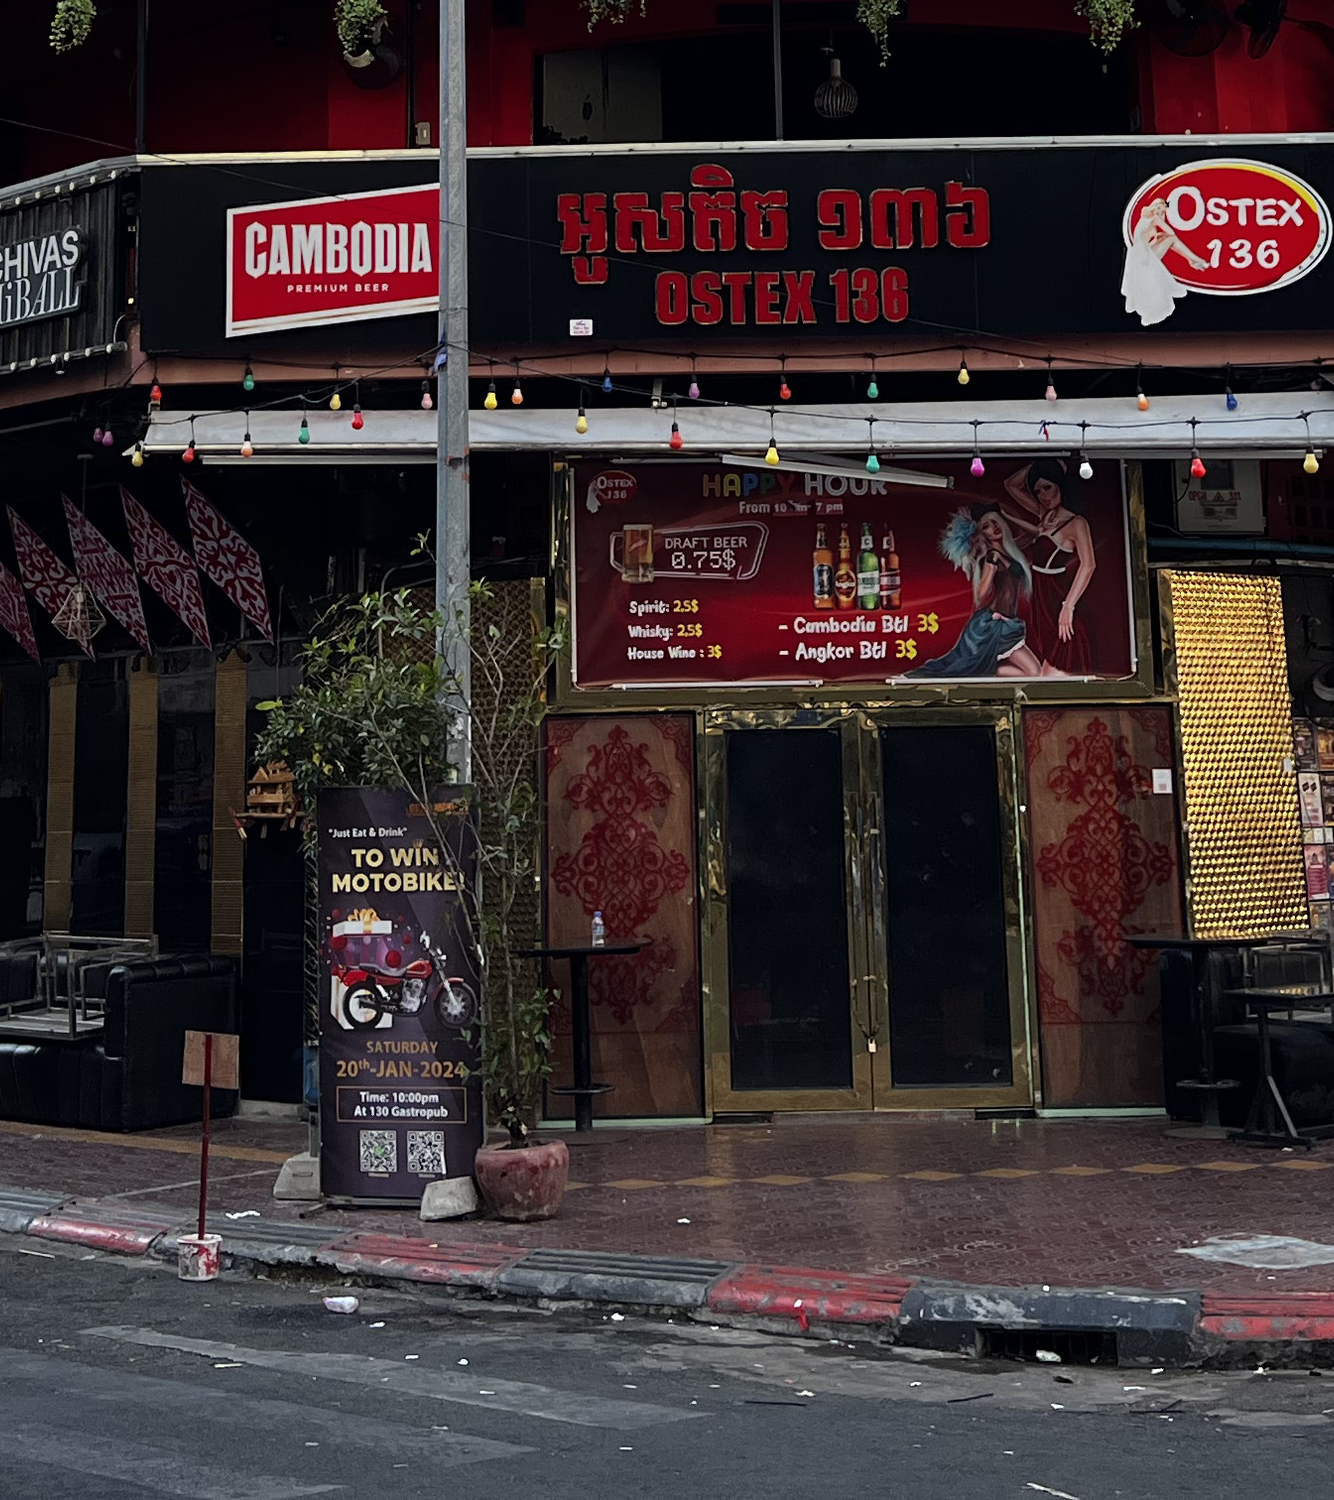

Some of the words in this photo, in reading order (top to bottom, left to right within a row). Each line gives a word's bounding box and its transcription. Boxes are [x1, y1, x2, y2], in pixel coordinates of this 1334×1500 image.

[817, 181, 990, 250] ១៣៦
[1167, 185, 1304, 231] OSTEX
[245, 221, 432, 279] CAMBODIA
[1207, 238, 1280, 269] 136
[287, 284, 348, 293] PREMIUM
[354, 283, 389, 292] BEER
[655, 269, 817, 325] OSTEX
[829, 266, 909, 324] 136
[703, 473, 796, 498] HAPPY
[804, 473, 888, 496] HOUR
[739, 502, 771, 514] From
[826, 503, 843, 514] pm
[665, 537, 709, 549] DRAFT
[714, 536, 748, 548] BEER
[671, 549, 736, 570] 0.75$
[629, 600, 670, 617] Spirit:
[673, 599, 699, 613] 2.5$
[627, 624, 673, 641] Whisky:
[677, 623, 703, 637] 2.5$
[793, 615, 876, 634] Cambodia
[881, 614, 908, 633] Btl
[917, 612, 939, 634] 3$
[627, 646, 664, 660] House
[667, 645, 696, 659] Wine
[707, 644, 722, 659] 3$
[795, 642, 854, 663] Angkor
[859, 640, 887, 658] Btl
[895, 638, 917, 660] 3$
[352, 828, 366, 838] Eat
[368, 827, 376, 837] &
[351, 848, 384, 867] TO
[389, 847, 439, 867] WIN
[366, 1041, 438, 1054] SATURDAY
[359, 1091, 389, 1103] Time:
[392, 1092, 439, 1105] 10:00pm
[354, 1105, 367, 1117] At
[370, 1106, 389, 1117] 130
[391, 1105, 448, 1119] Gastropub
